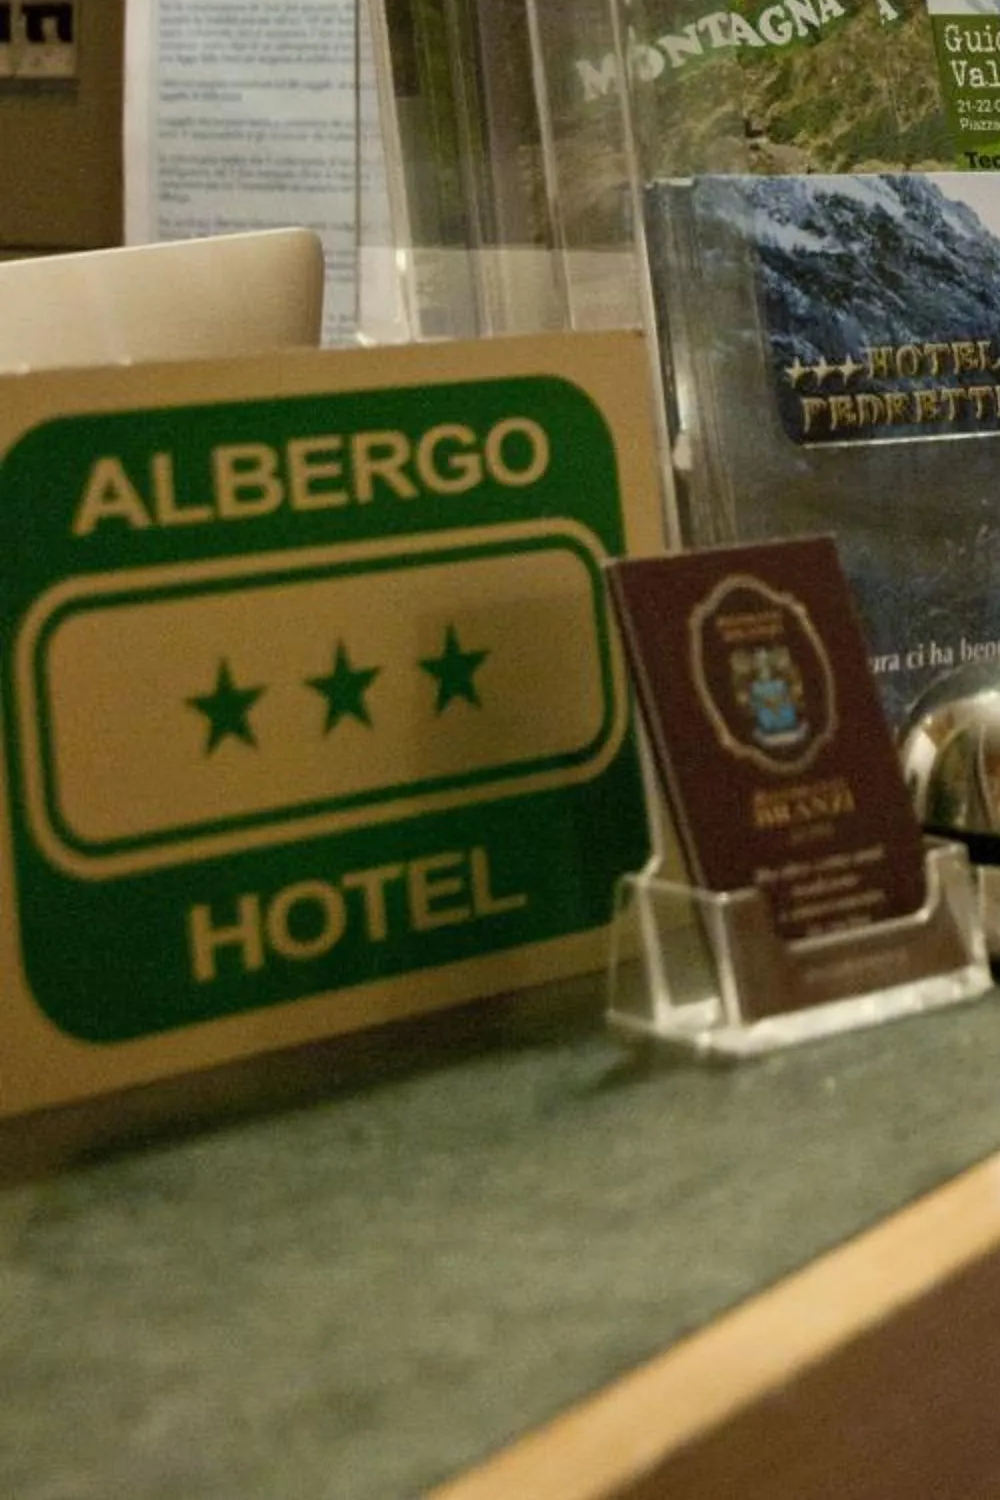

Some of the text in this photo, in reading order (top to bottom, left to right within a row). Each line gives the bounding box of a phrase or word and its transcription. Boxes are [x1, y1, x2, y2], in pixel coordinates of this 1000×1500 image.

[960, 117, 1000, 132] Piazza
[71, 416, 551, 537] ALBERGO
[872, 652, 899, 675] ura
[906, 644, 925, 668] ci
[930, 639, 955, 666] ha
[187, 846, 528, 983] HOTEL
